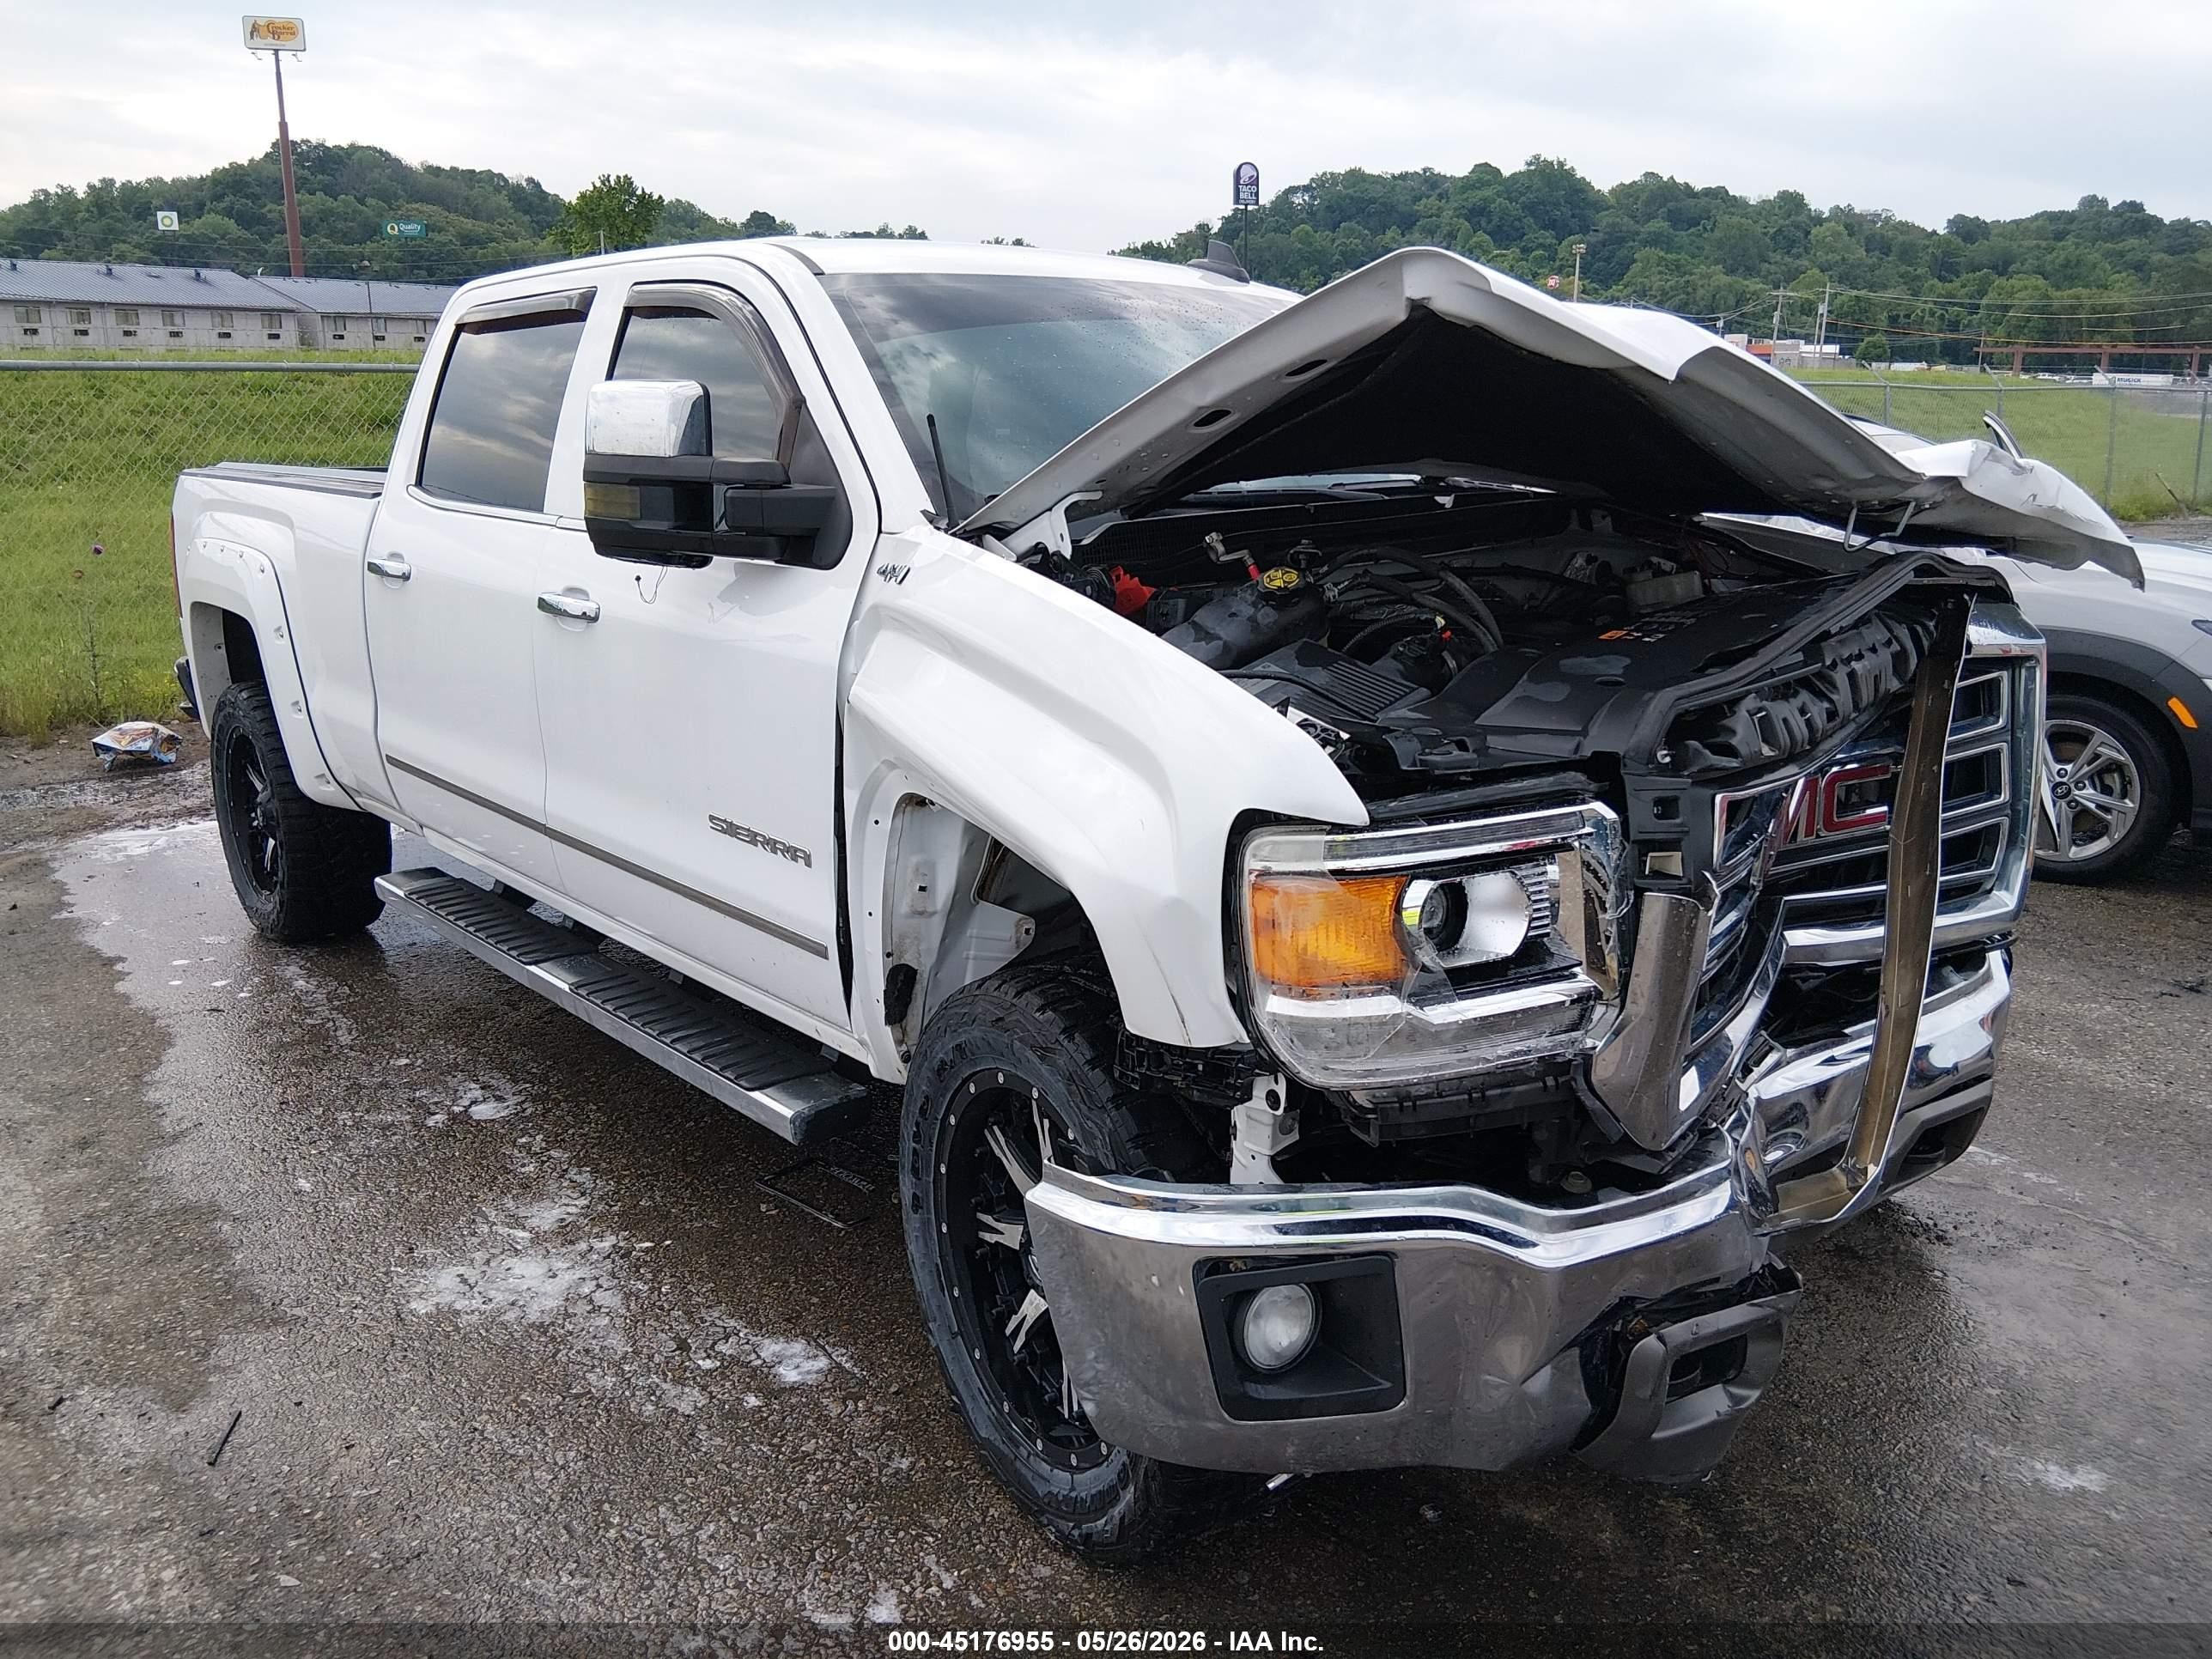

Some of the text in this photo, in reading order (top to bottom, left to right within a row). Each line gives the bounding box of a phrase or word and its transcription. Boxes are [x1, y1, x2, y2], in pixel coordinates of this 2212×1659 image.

[399, 223, 421, 232] Quality
[1774, 763, 1893, 848] MC
[708, 811, 812, 869] SIERRA
